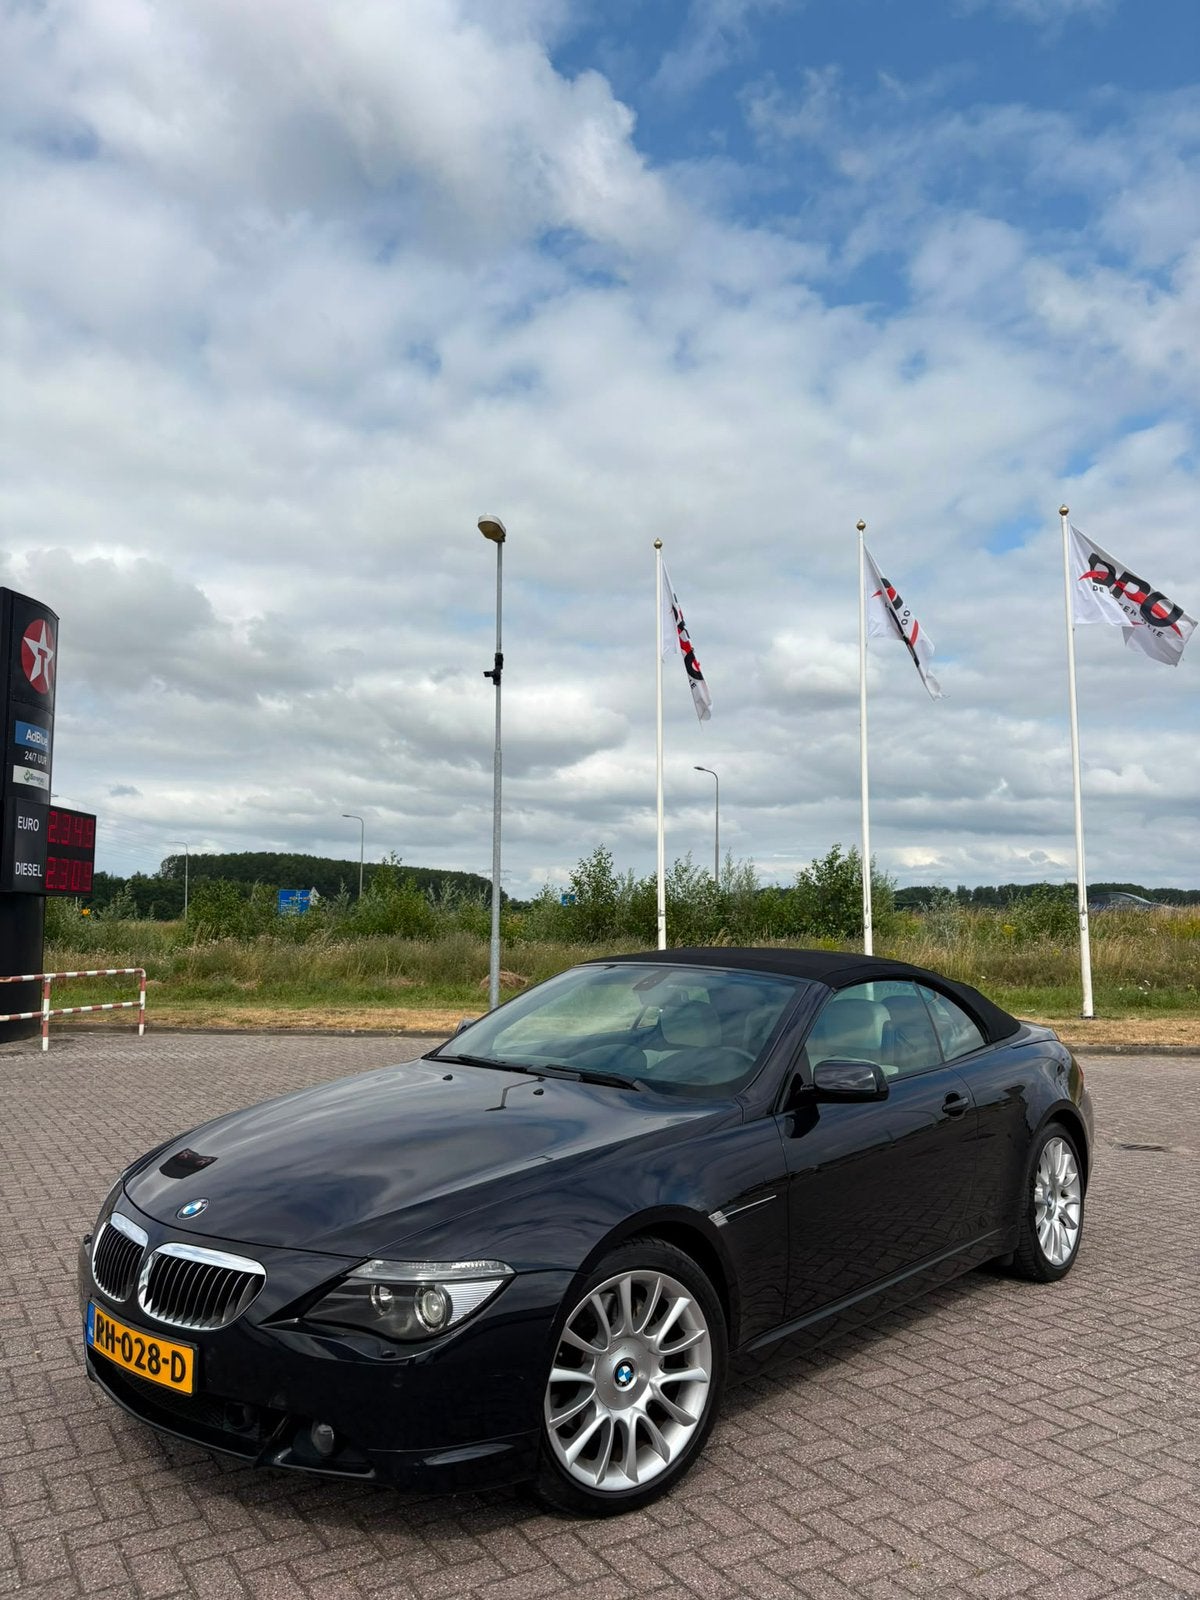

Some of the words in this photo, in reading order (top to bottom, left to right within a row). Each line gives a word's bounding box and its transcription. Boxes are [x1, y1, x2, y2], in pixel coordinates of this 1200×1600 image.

[1092, 584, 1105, 593] DE
[25, 729, 48, 747] AdBlue
[24, 750, 37, 762] 24/7
[17, 815, 40, 832] EURO
[15, 861, 43, 878] DIESEL
[95, 1313, 187, 1384] RH-028-D
